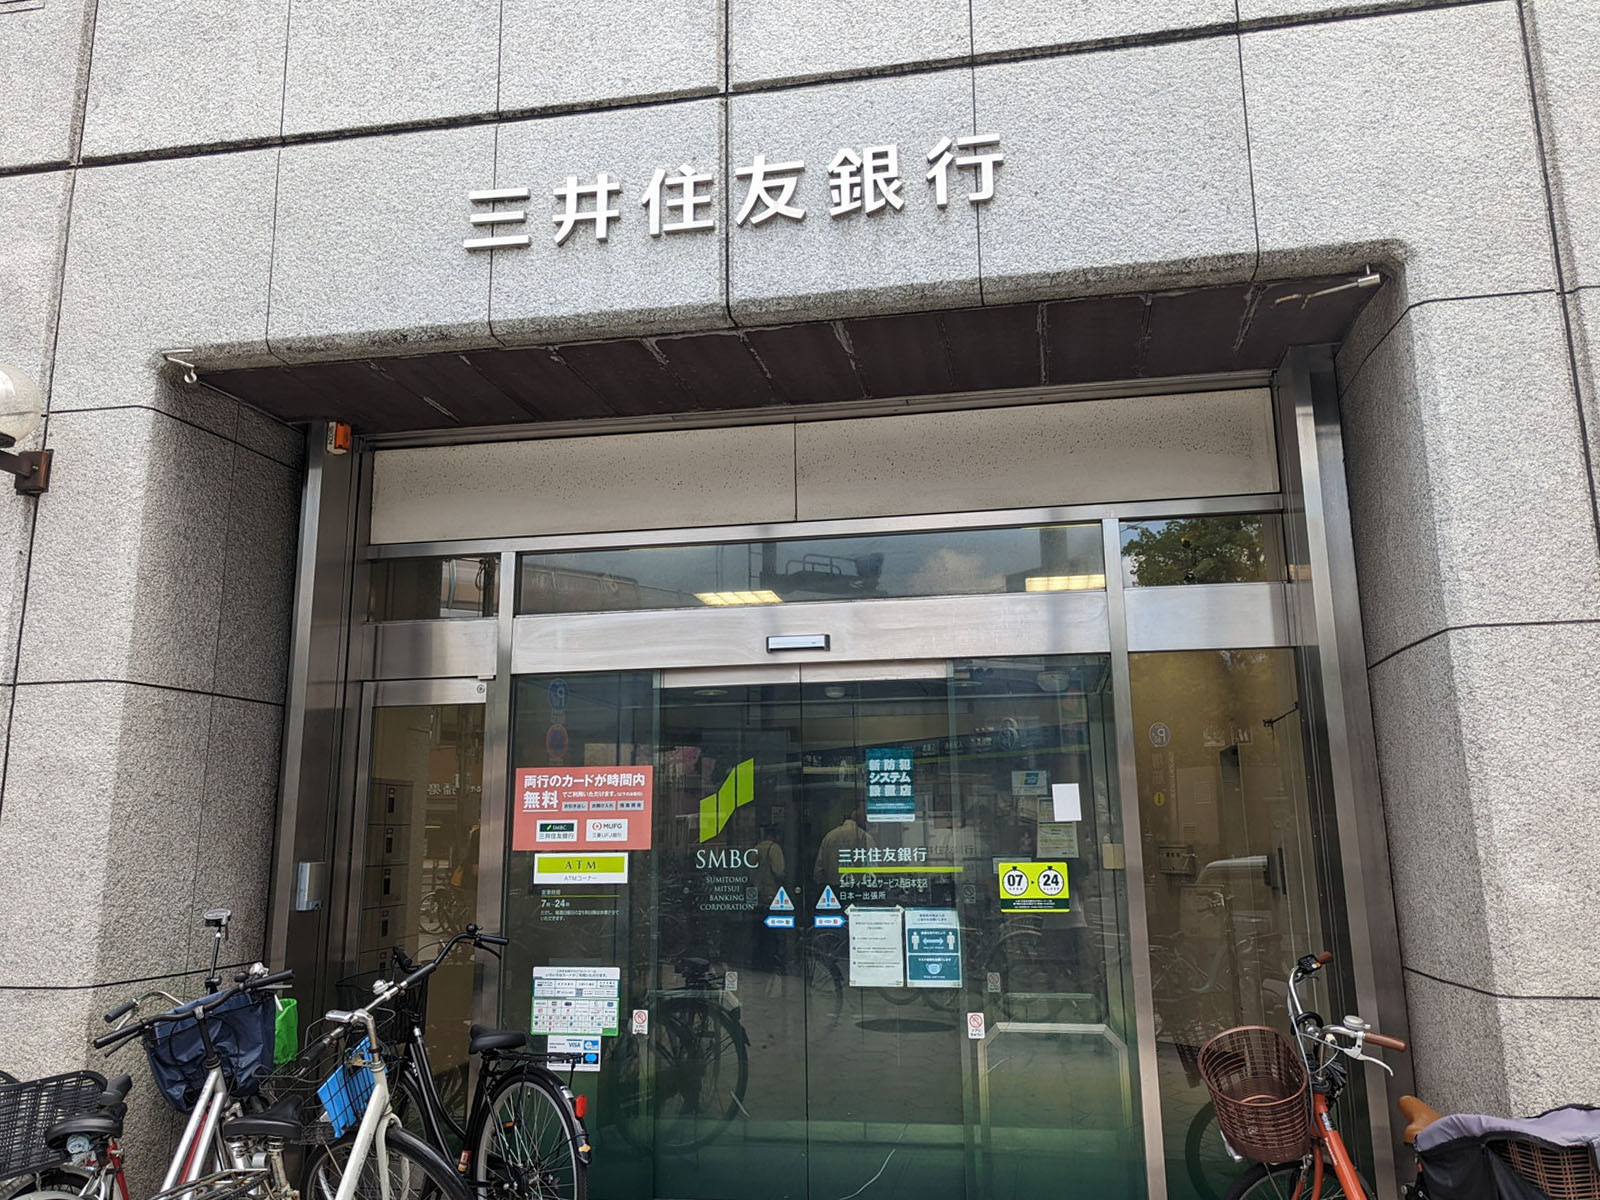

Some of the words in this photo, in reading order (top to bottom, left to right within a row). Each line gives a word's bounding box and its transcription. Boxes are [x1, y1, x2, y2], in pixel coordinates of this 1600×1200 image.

[463, 132, 1004, 251] 三井住友銀行
[869, 758, 911, 771] 新防犯
[524, 773, 645, 788] 両行のカードが時間内
[869, 772, 912, 784] システム
[869, 784, 912, 797] 設置店
[523, 791, 559, 809] 無料
[696, 848, 760, 869] SMBC
[838, 848, 928, 863] 三井住友銀行
[564, 861, 596, 870] ATM
[1008, 874, 1023, 886] 07
[1042, 874, 1059, 886] 24
[840, 891, 886, 900] 日本一出張所
